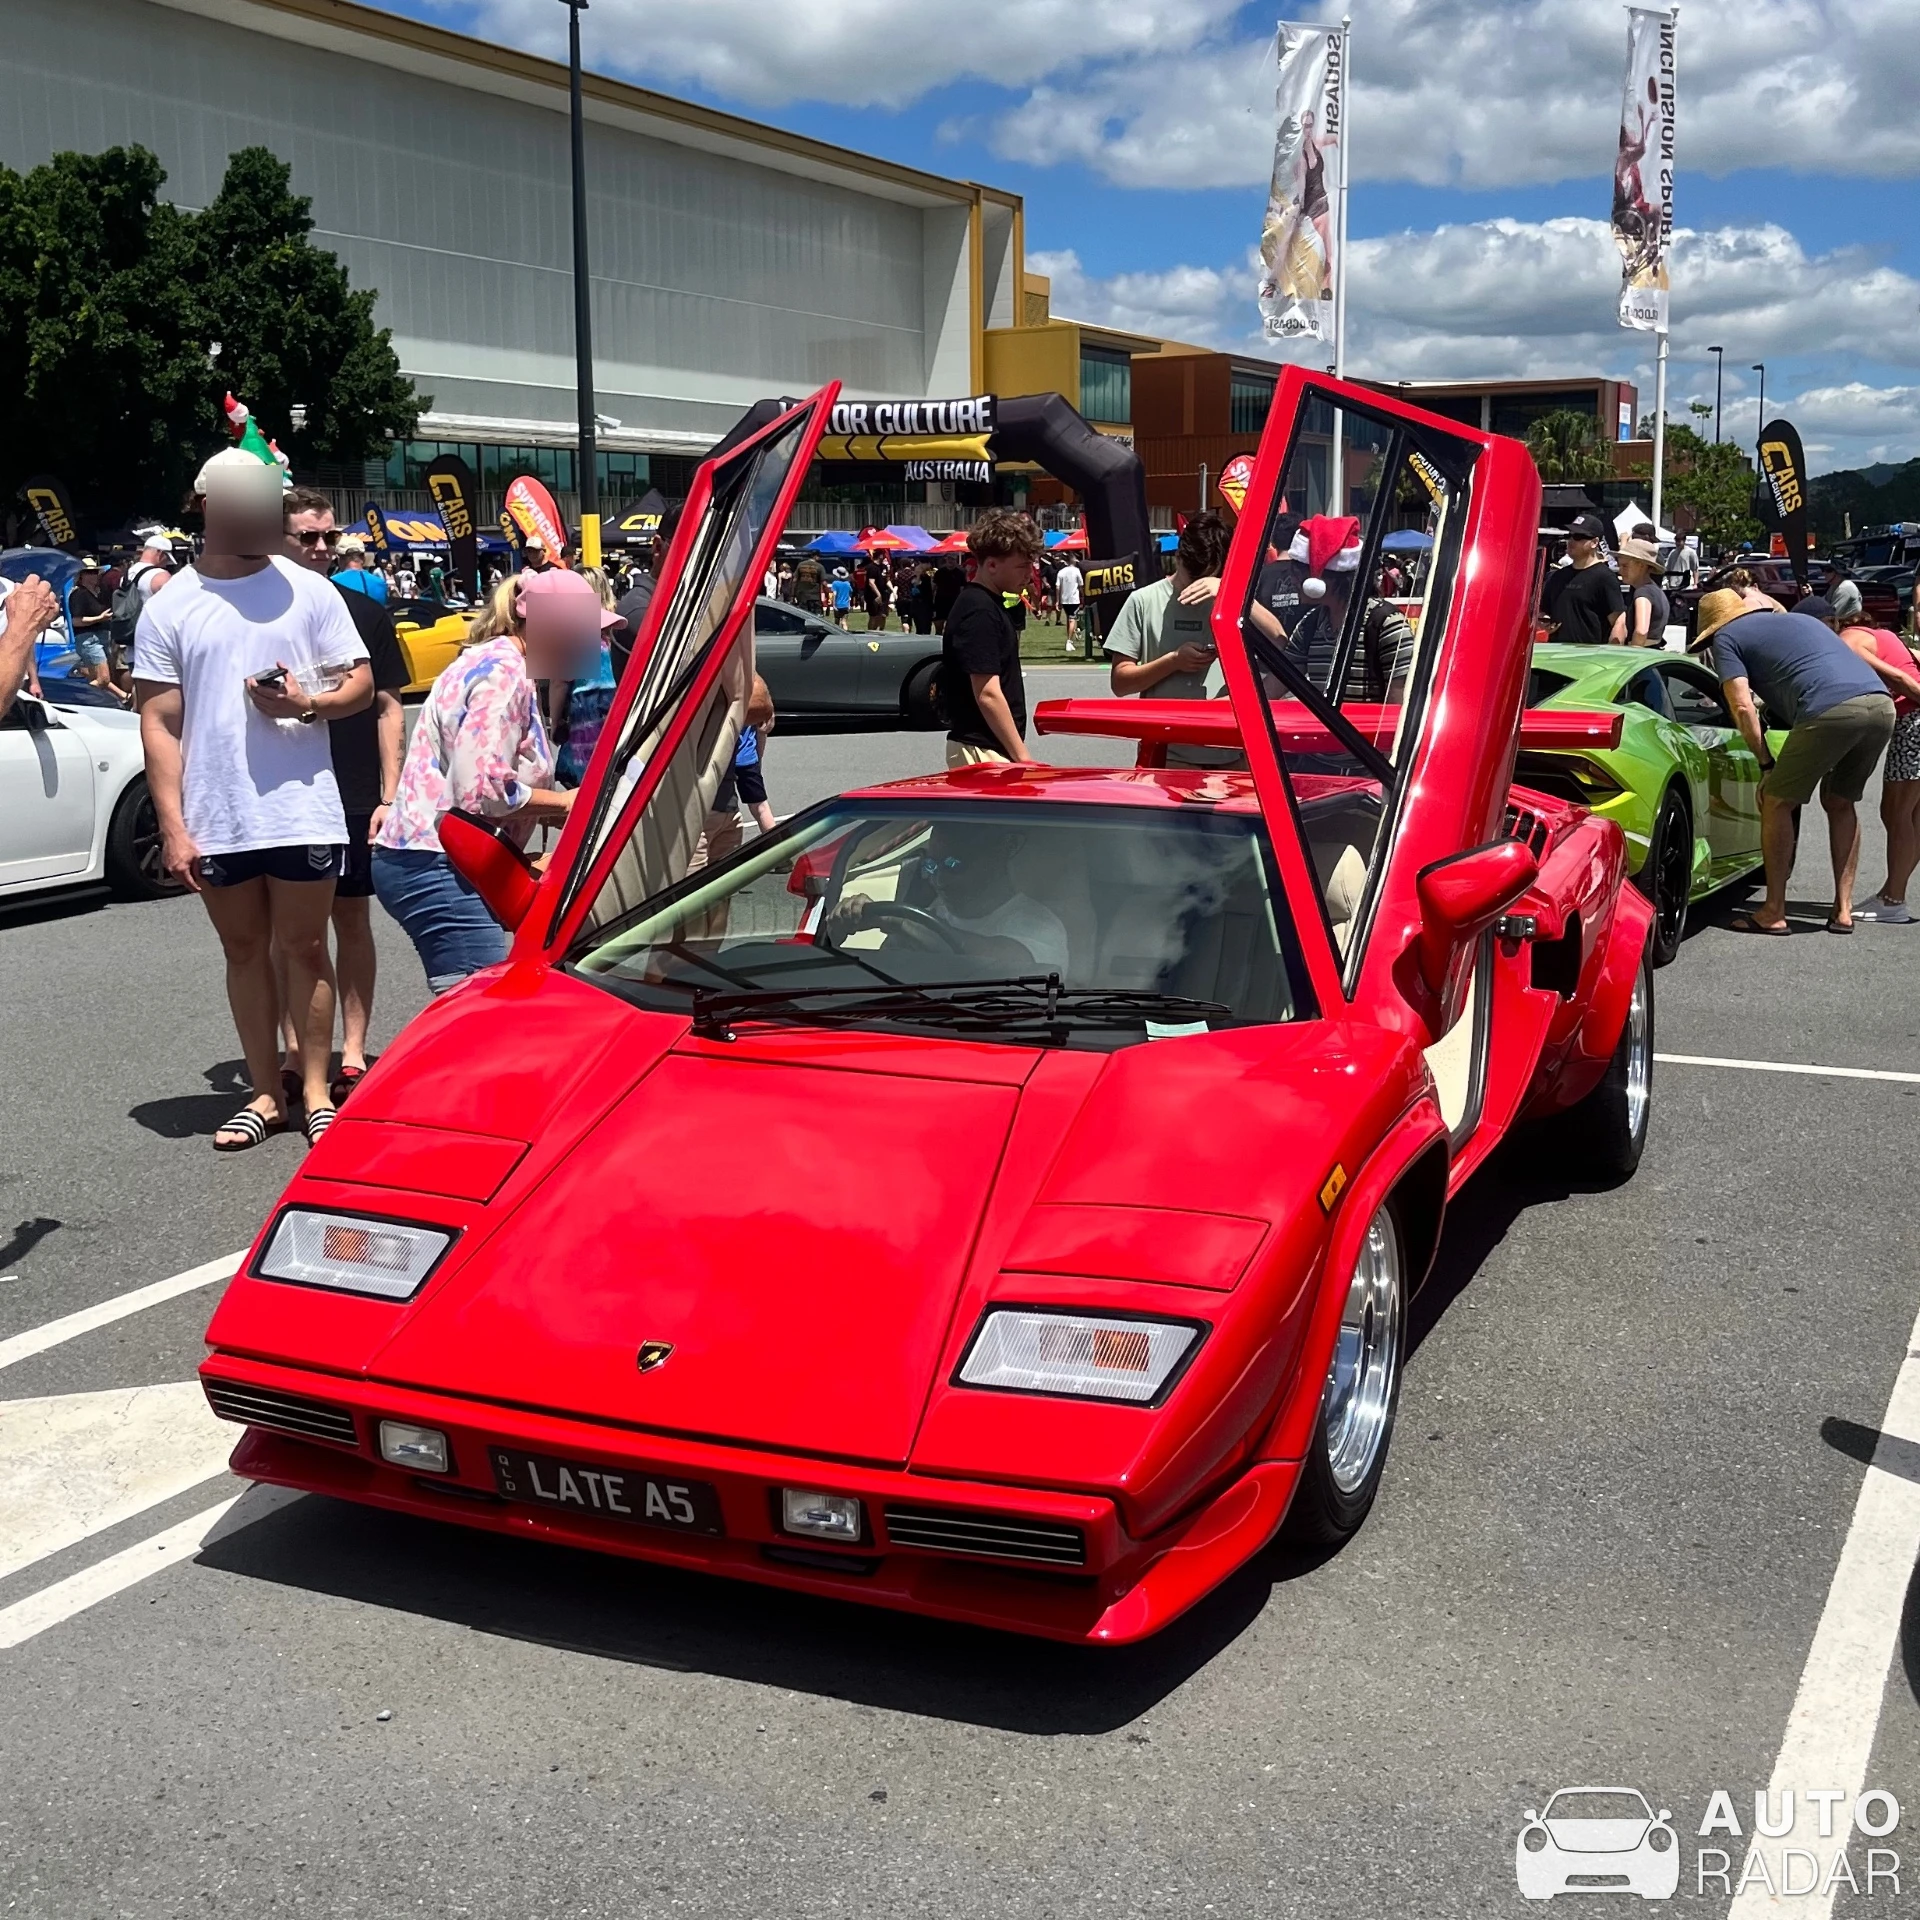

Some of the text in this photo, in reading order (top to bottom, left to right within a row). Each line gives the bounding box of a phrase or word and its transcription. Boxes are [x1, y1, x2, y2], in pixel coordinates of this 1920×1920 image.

[875, 396, 993, 434] CULTURE
[904, 460, 990, 483] AUSTRALIA
[1761, 441, 1802, 513] CARS
[27, 489, 75, 542] CARS
[428, 474, 472, 538] CARS
[1772, 482, 1787, 518] CULTURE
[1085, 563, 1134, 596] CARS
[498, 1455, 516, 1491] QLD
[527, 1461, 695, 1523] LATE A5
